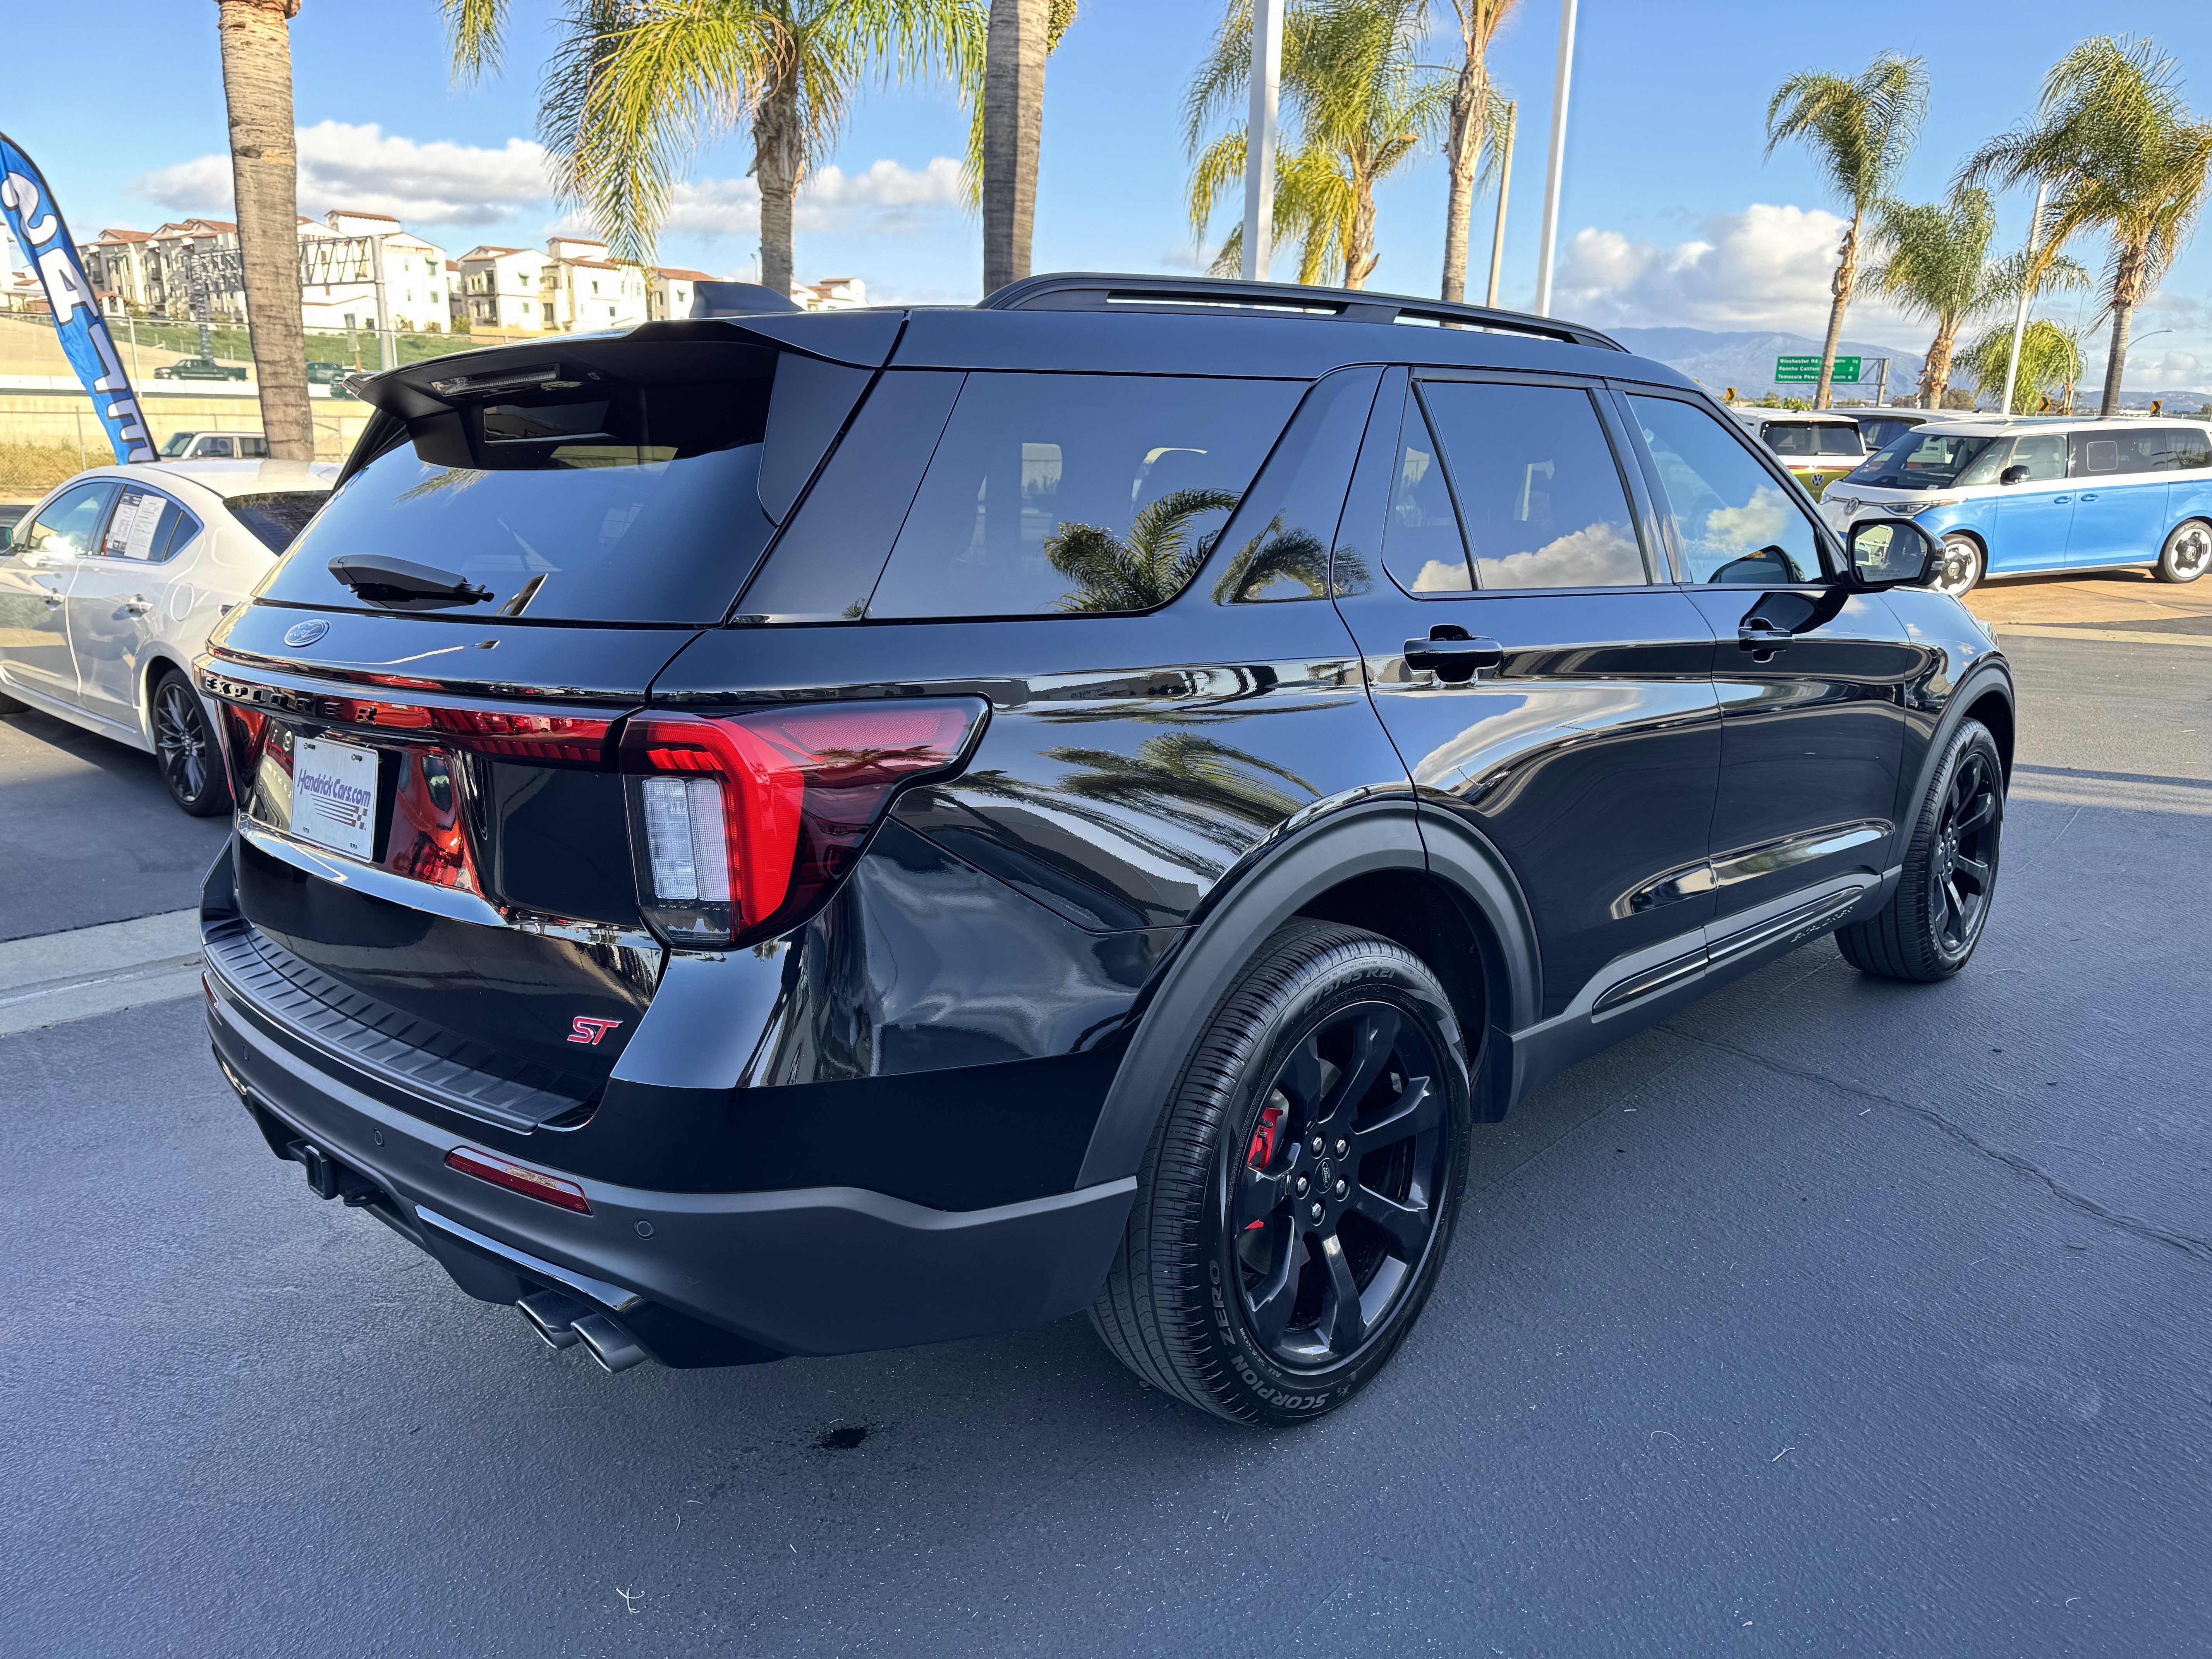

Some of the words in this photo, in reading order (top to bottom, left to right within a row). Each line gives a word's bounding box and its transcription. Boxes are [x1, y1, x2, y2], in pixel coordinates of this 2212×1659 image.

[205, 677, 378, 725] EXPLORER
[567, 1016, 623, 1045] ST
[1209, 1259, 1236, 1346] ZERO
[1231, 1354, 1330, 1410] SCORPION
